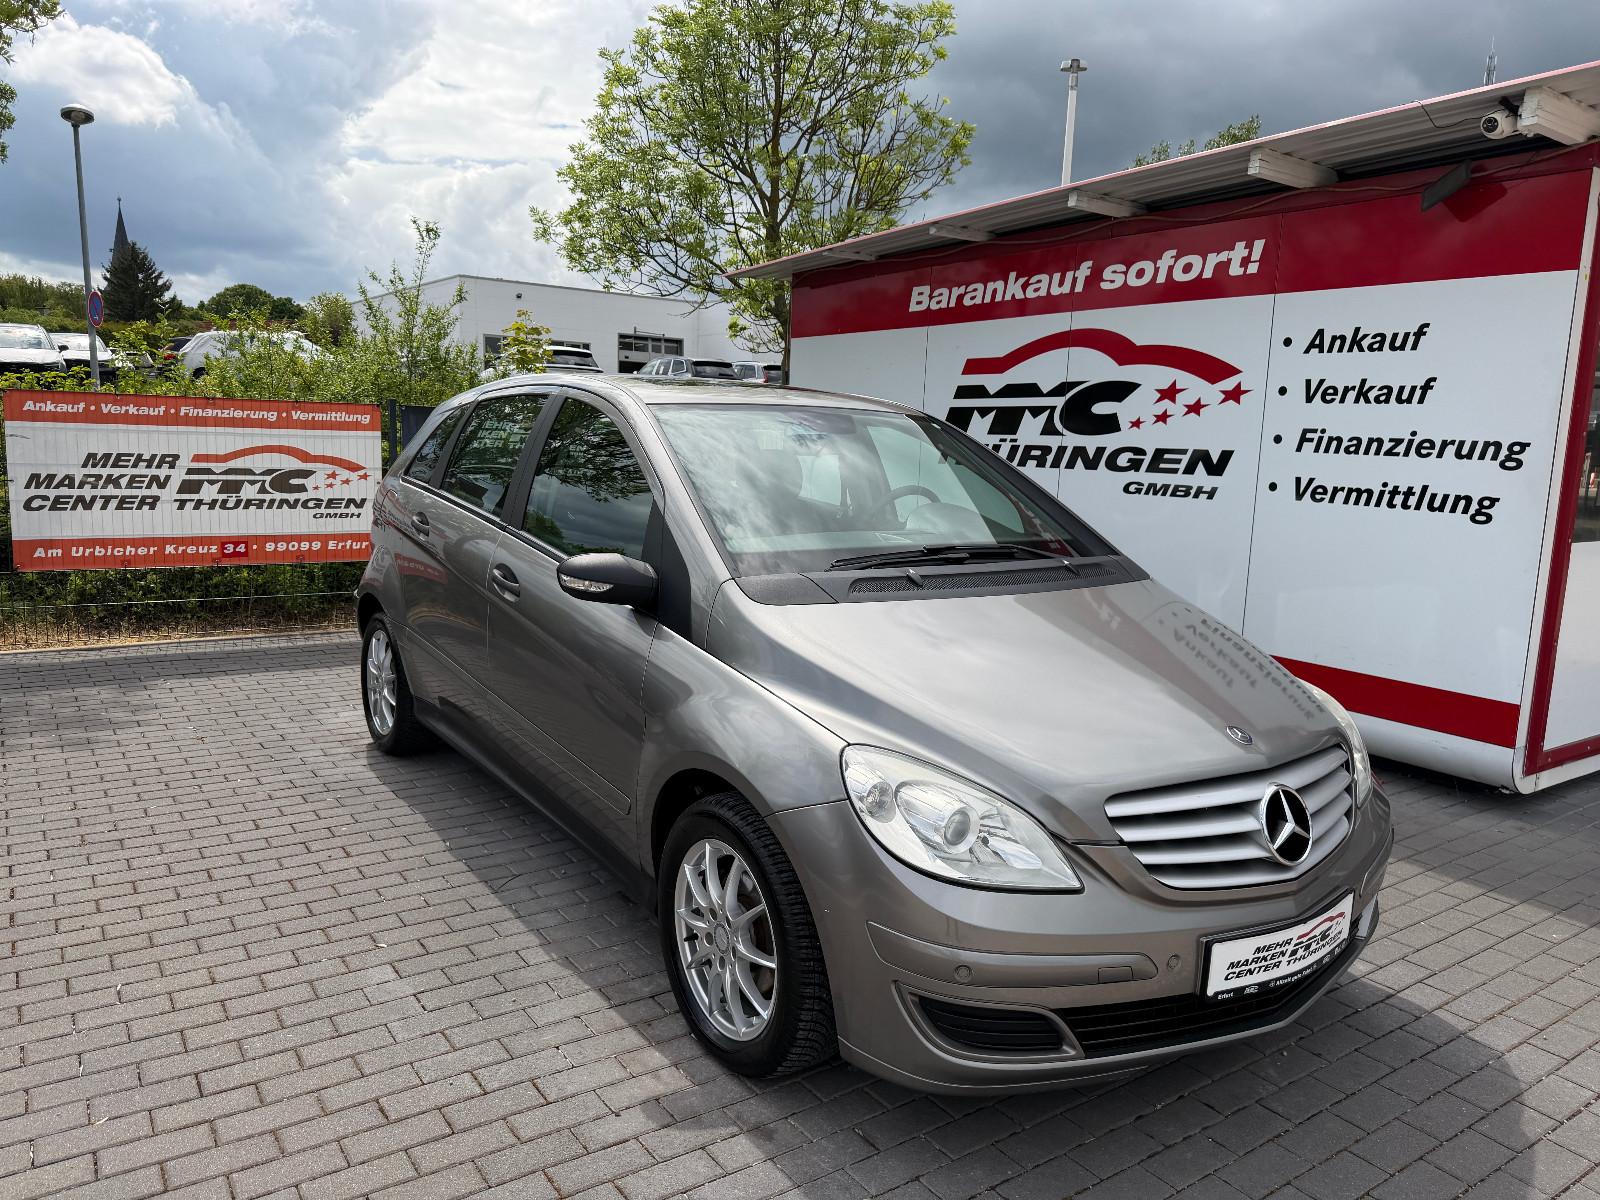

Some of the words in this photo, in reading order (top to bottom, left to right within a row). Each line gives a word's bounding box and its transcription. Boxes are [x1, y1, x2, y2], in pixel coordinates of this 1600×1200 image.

[908, 260, 1093, 312] Barankauf
[1100, 239, 1266, 290] sofort!
[1303, 322, 1430, 354] Ankauf
[1304, 376, 1437, 405] Verkauf
[23, 401, 85, 414] Ankauf
[100, 403, 166, 417] Verkauf
[179, 405, 277, 422] Finanzierung
[291, 410, 370, 424] Vermittlung
[984, 438, 1234, 477] ÜRINGEN
[1295, 427, 1531, 471] Finanzierung
[81, 452, 181, 469] MEHR
[23, 473, 171, 490] MARKEN
[1122, 481, 1219, 500] GMBH
[22, 494, 162, 511] CENTER
[173, 495, 367, 511] THÜRINGEN
[1294, 476, 1500, 525] Vermittlung
[33, 547, 63, 558] Am
[71, 544, 157, 557] Urbicher
[164, 542, 218, 555] Kreuz
[223, 543, 247, 554] 34
[265, 540, 322, 552] 99099
[328, 540, 369, 550] Erfur
[1253, 937, 1293, 955] MEHR
[1226, 949, 1289, 970] MARKEN
[1224, 960, 1283, 981] CENTER
